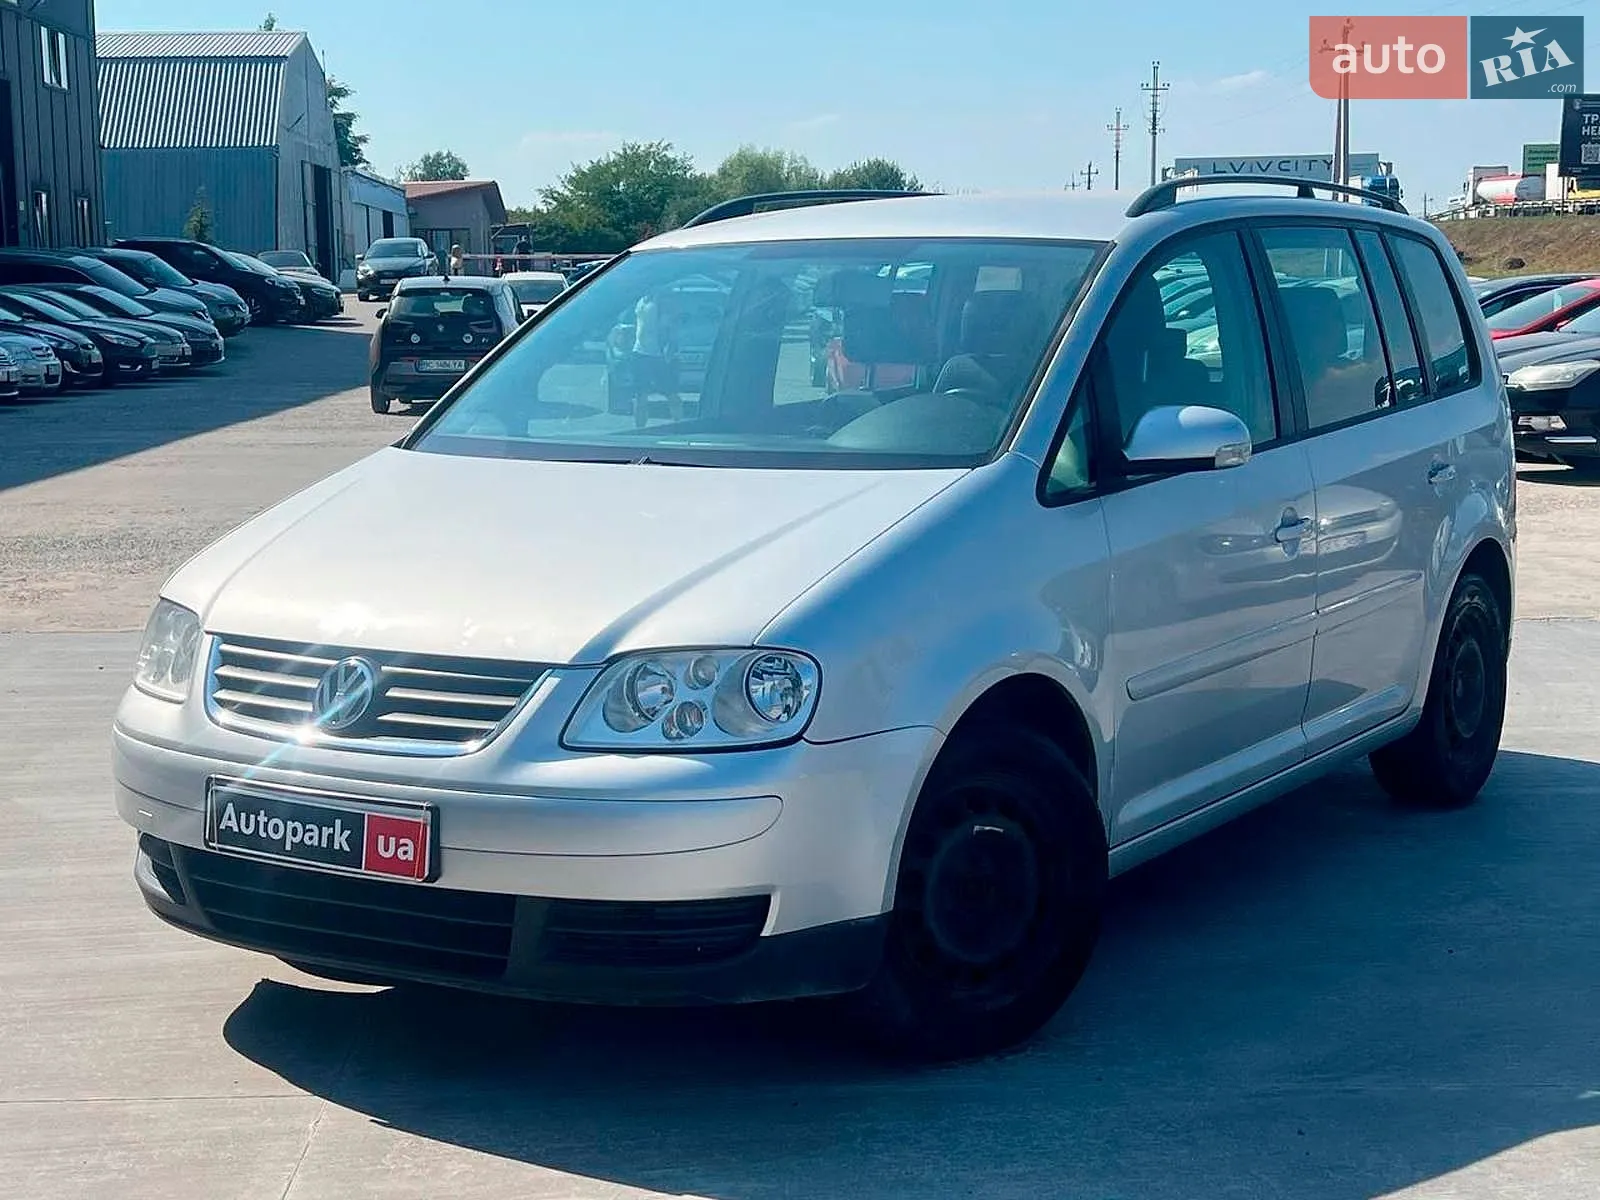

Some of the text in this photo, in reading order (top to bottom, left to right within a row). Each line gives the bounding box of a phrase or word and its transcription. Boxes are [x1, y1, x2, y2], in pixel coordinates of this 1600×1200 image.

[1582, 114, 1600, 124] ТР
[219, 802, 414, 861] Autopark ua
